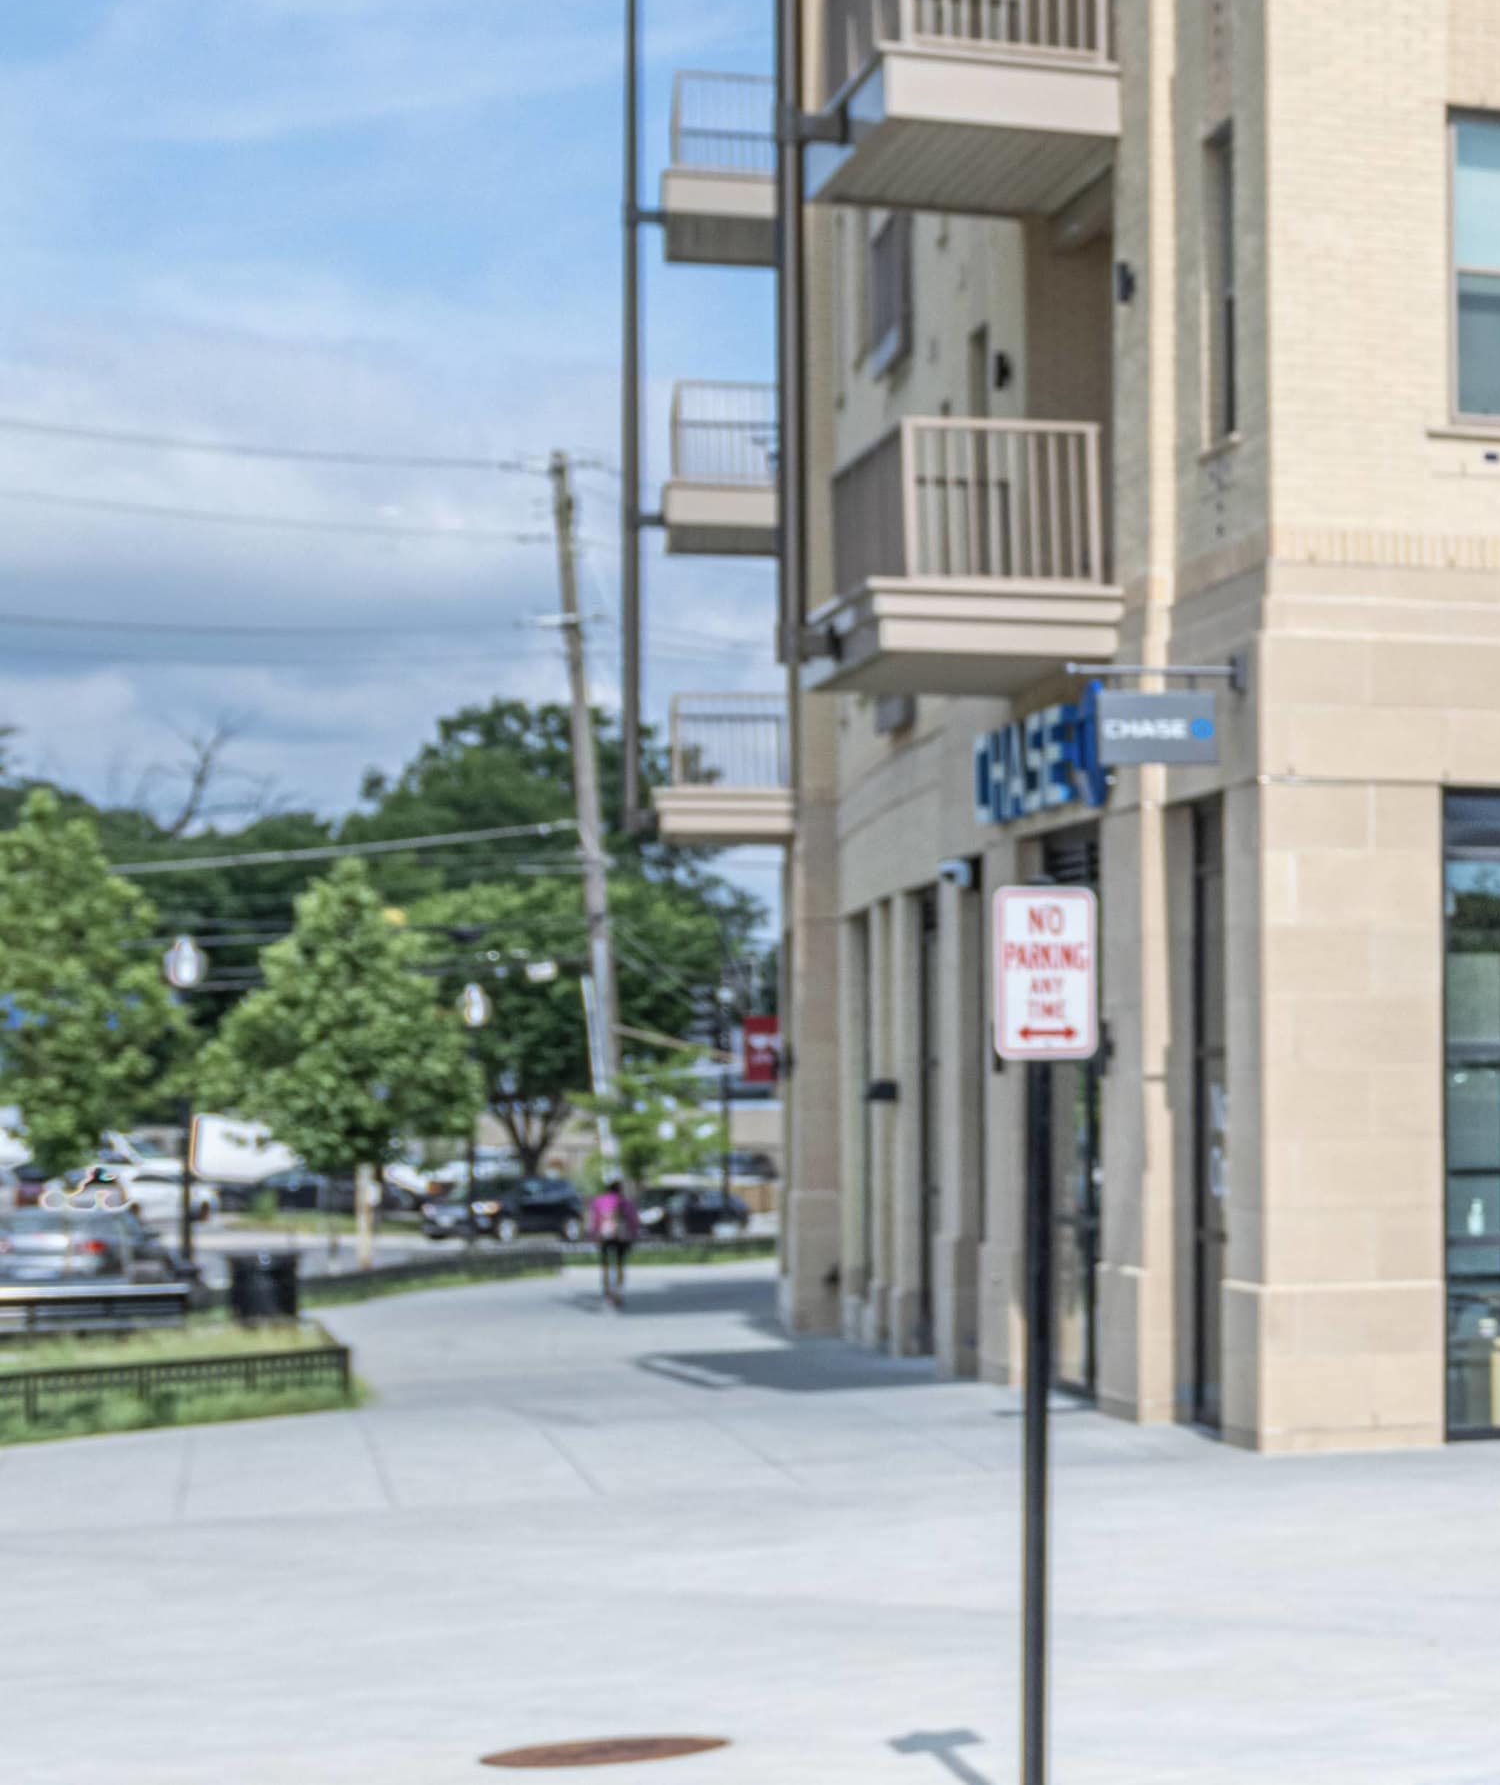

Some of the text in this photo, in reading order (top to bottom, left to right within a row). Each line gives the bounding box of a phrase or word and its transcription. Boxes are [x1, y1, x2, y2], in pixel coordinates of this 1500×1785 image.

[1103, 718, 1188, 741] CHASE
[974, 703, 1077, 823] CHASE
[1028, 906, 1065, 934] NO
[1004, 944, 1089, 969] PARKING
[1030, 978, 1063, 994] ANY
[1028, 1001, 1065, 1018] TIME
